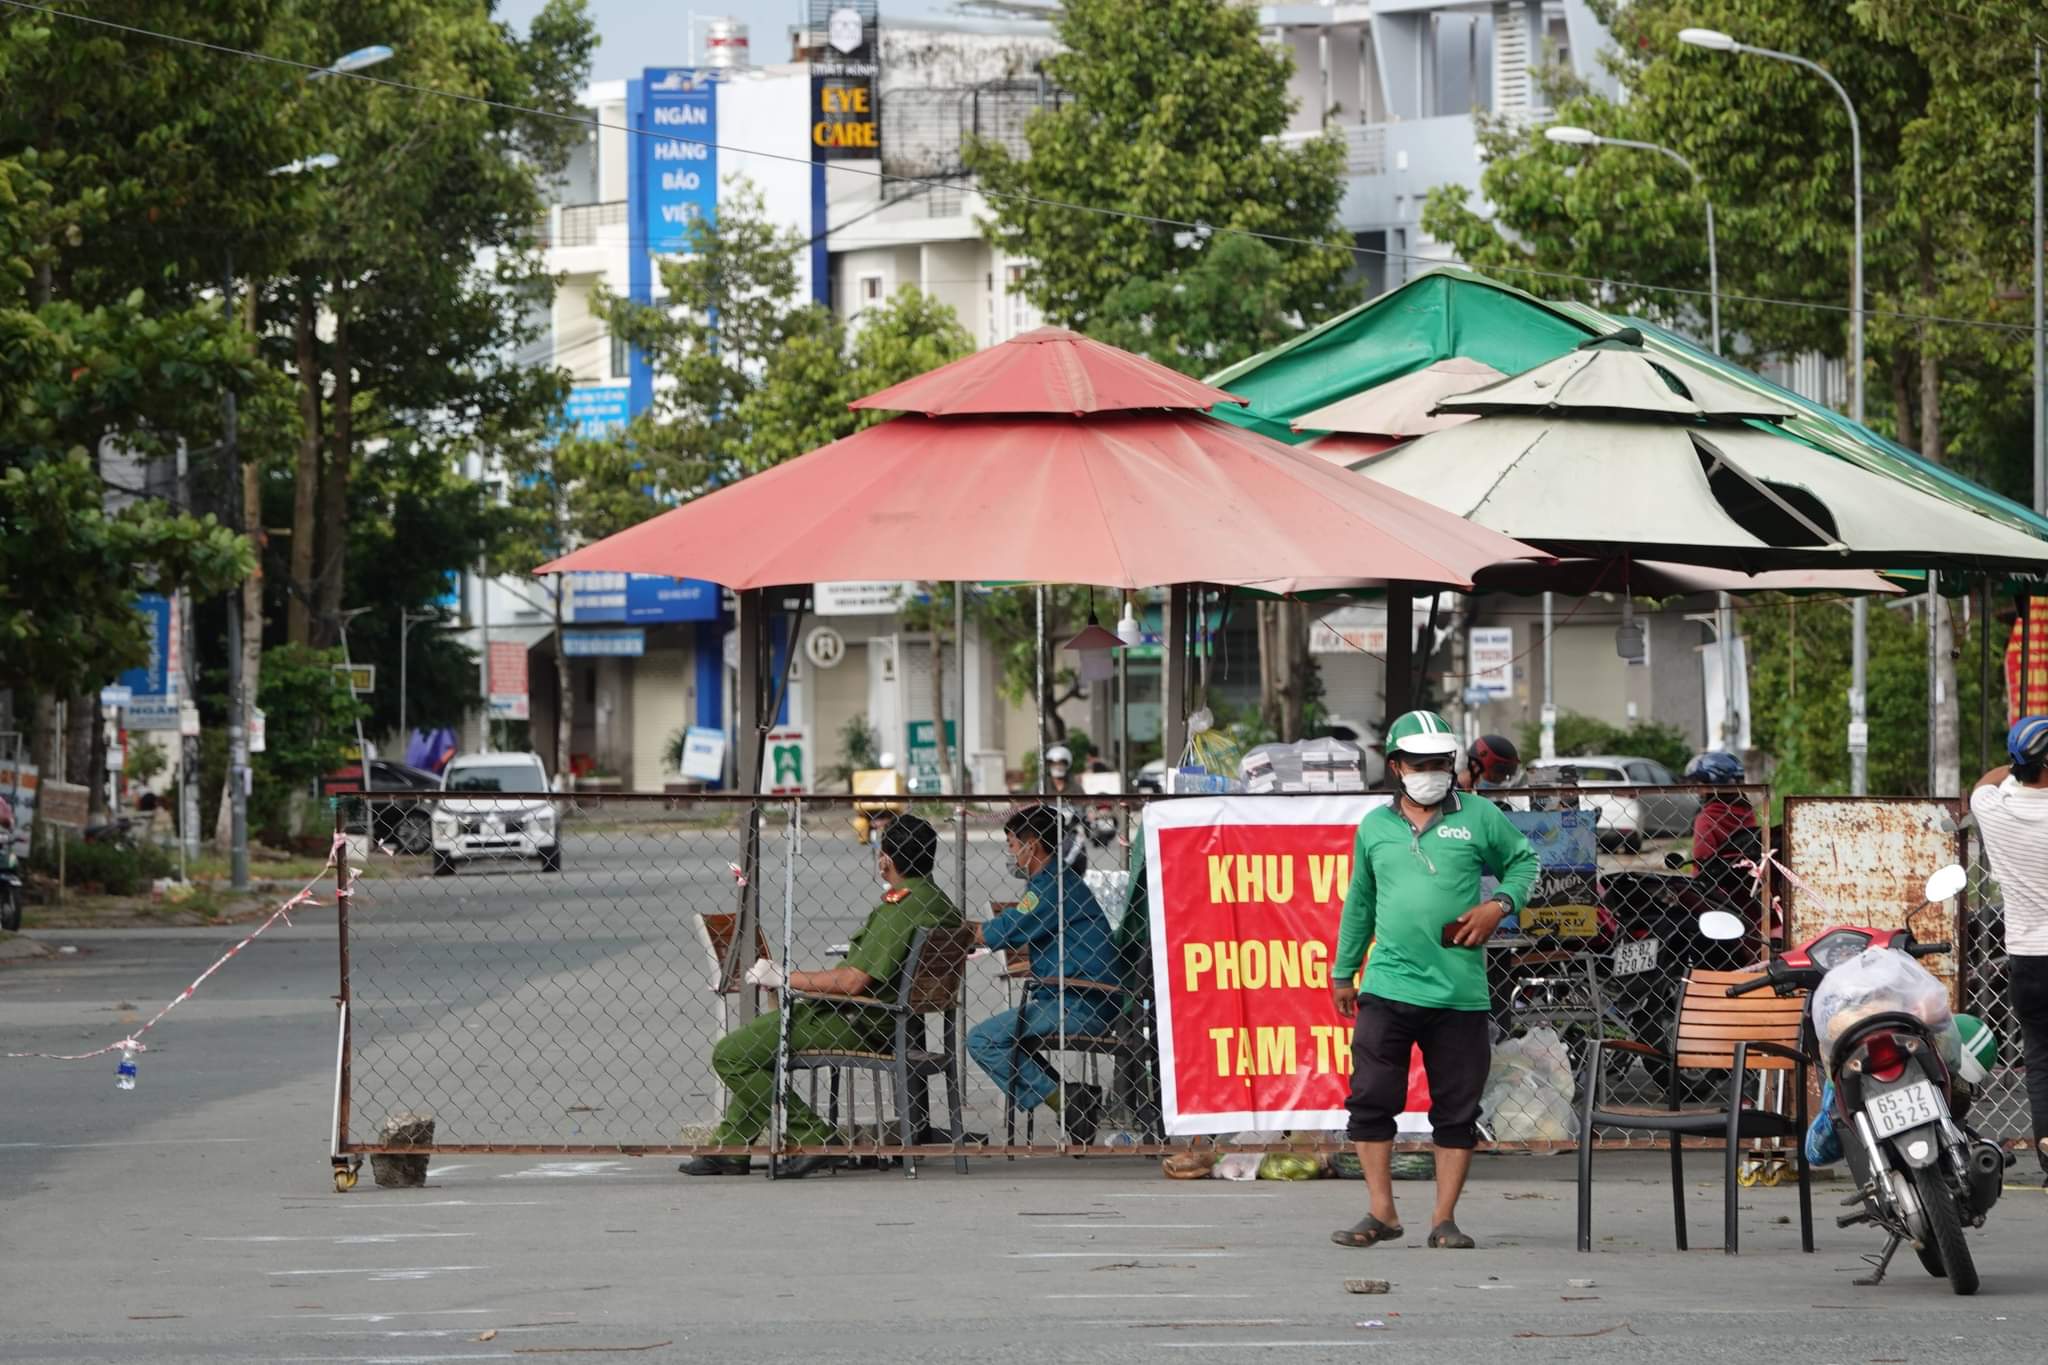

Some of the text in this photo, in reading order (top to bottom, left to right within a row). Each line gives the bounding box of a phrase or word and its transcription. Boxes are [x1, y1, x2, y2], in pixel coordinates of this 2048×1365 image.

[821, 87, 869, 112] EYE
[654, 104, 706, 124] NGÂN
[813, 122, 879, 146] CARE
[654, 142, 707, 160] HÀNG
[662, 171, 699, 190] BẢO
[1437, 826, 1471, 840] Grab
[1208, 855, 1294, 904] KHU
[1183, 939, 1328, 992] PHONG
[1209, 1026, 1354, 1087] TẠM TH
[1877, 1086, 1925, 1113] 65-T2
[1883, 1102, 1930, 1131] 0525
